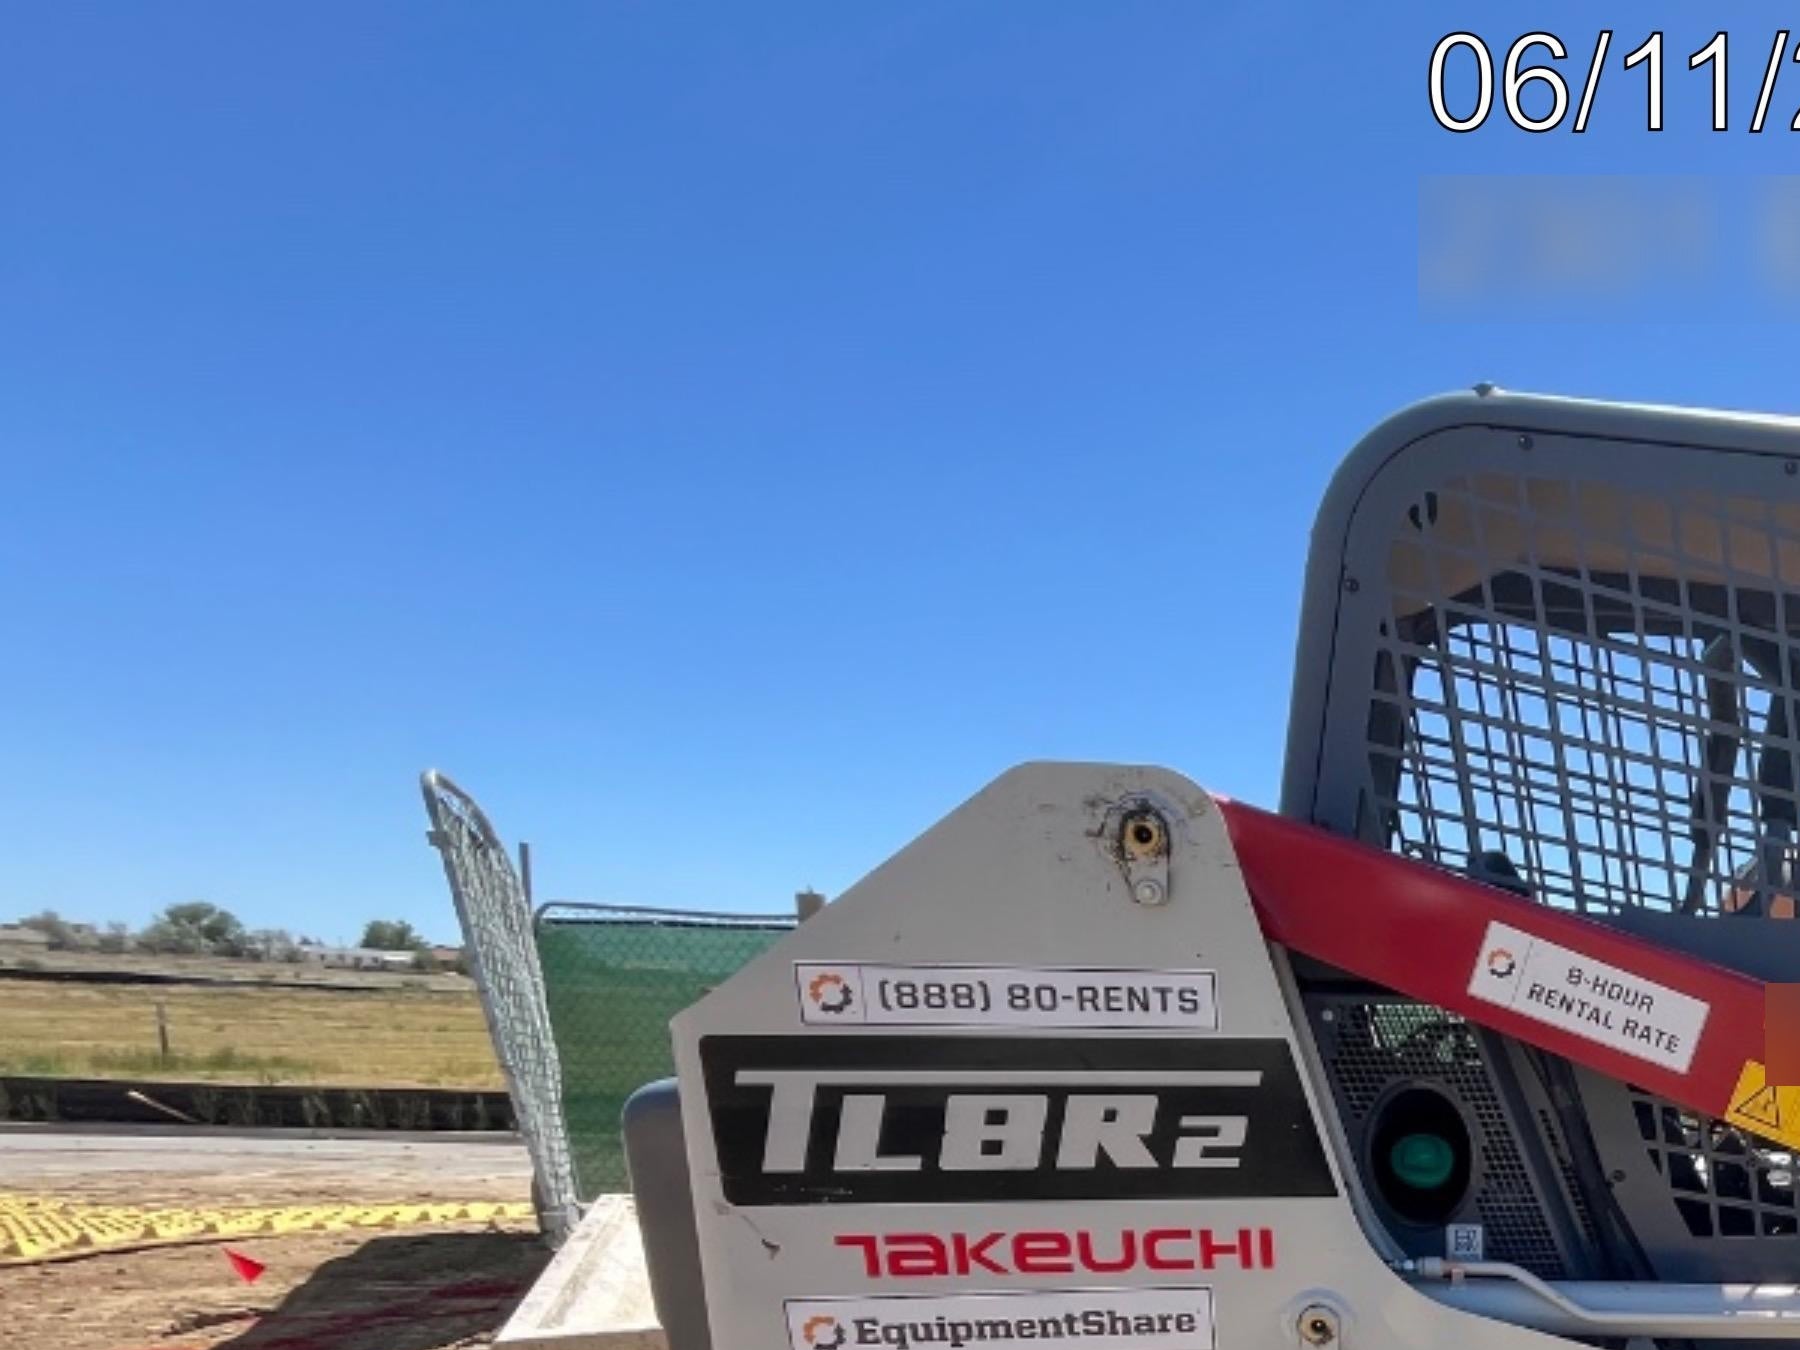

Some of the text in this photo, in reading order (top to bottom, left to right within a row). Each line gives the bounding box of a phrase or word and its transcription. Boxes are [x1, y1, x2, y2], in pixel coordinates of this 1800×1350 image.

[878, 979, 1200, 1014] (888) 80-RENTS
[1566, 966, 1654, 1014] 8-HOUR
[1527, 983, 1681, 1054] RENTAL RATE
[735, 1069, 1263, 1172] TL8R2
[852, 1310, 1197, 1350] EquipmentShare
